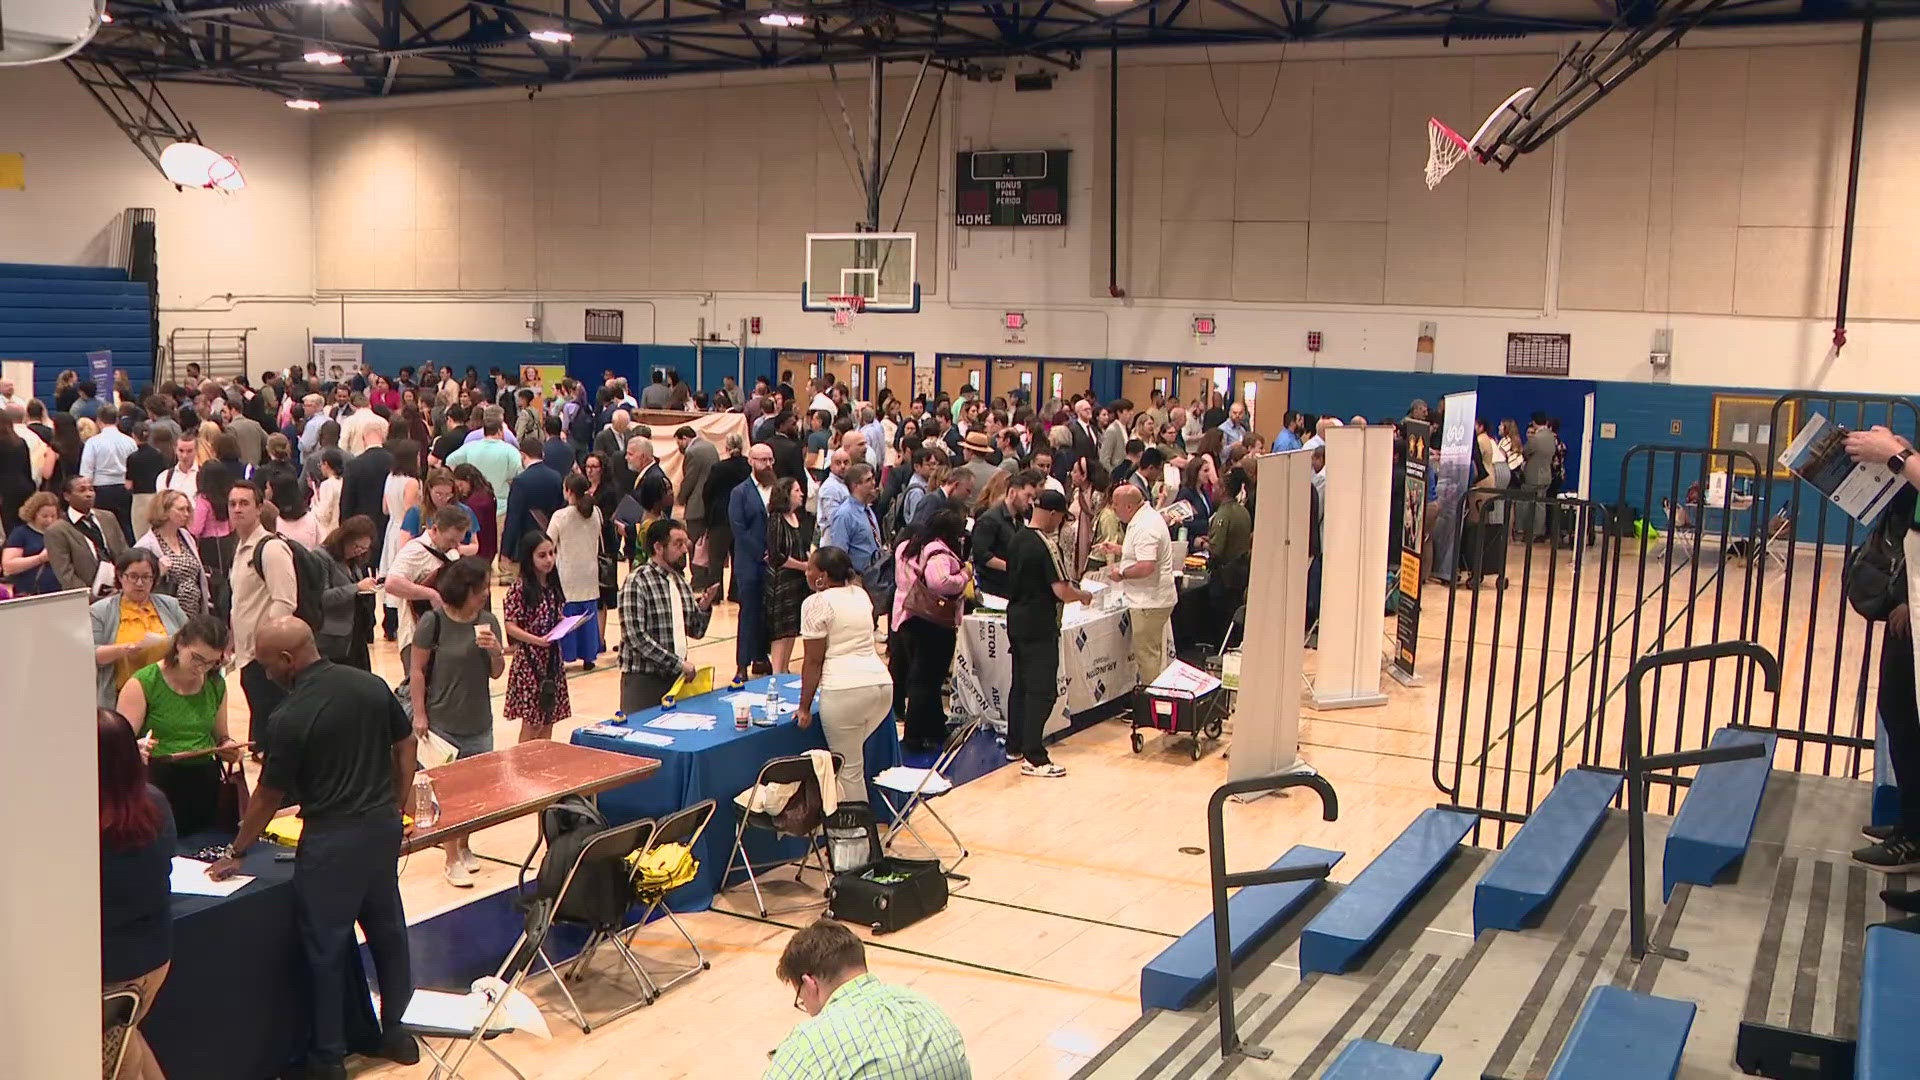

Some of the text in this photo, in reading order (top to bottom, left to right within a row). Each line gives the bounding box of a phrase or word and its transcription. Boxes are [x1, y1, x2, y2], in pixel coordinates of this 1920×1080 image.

[995, 181, 1021, 189] BONUS
[957, 214, 992, 225] HOME
[1021, 213, 1062, 225] VISITOR
